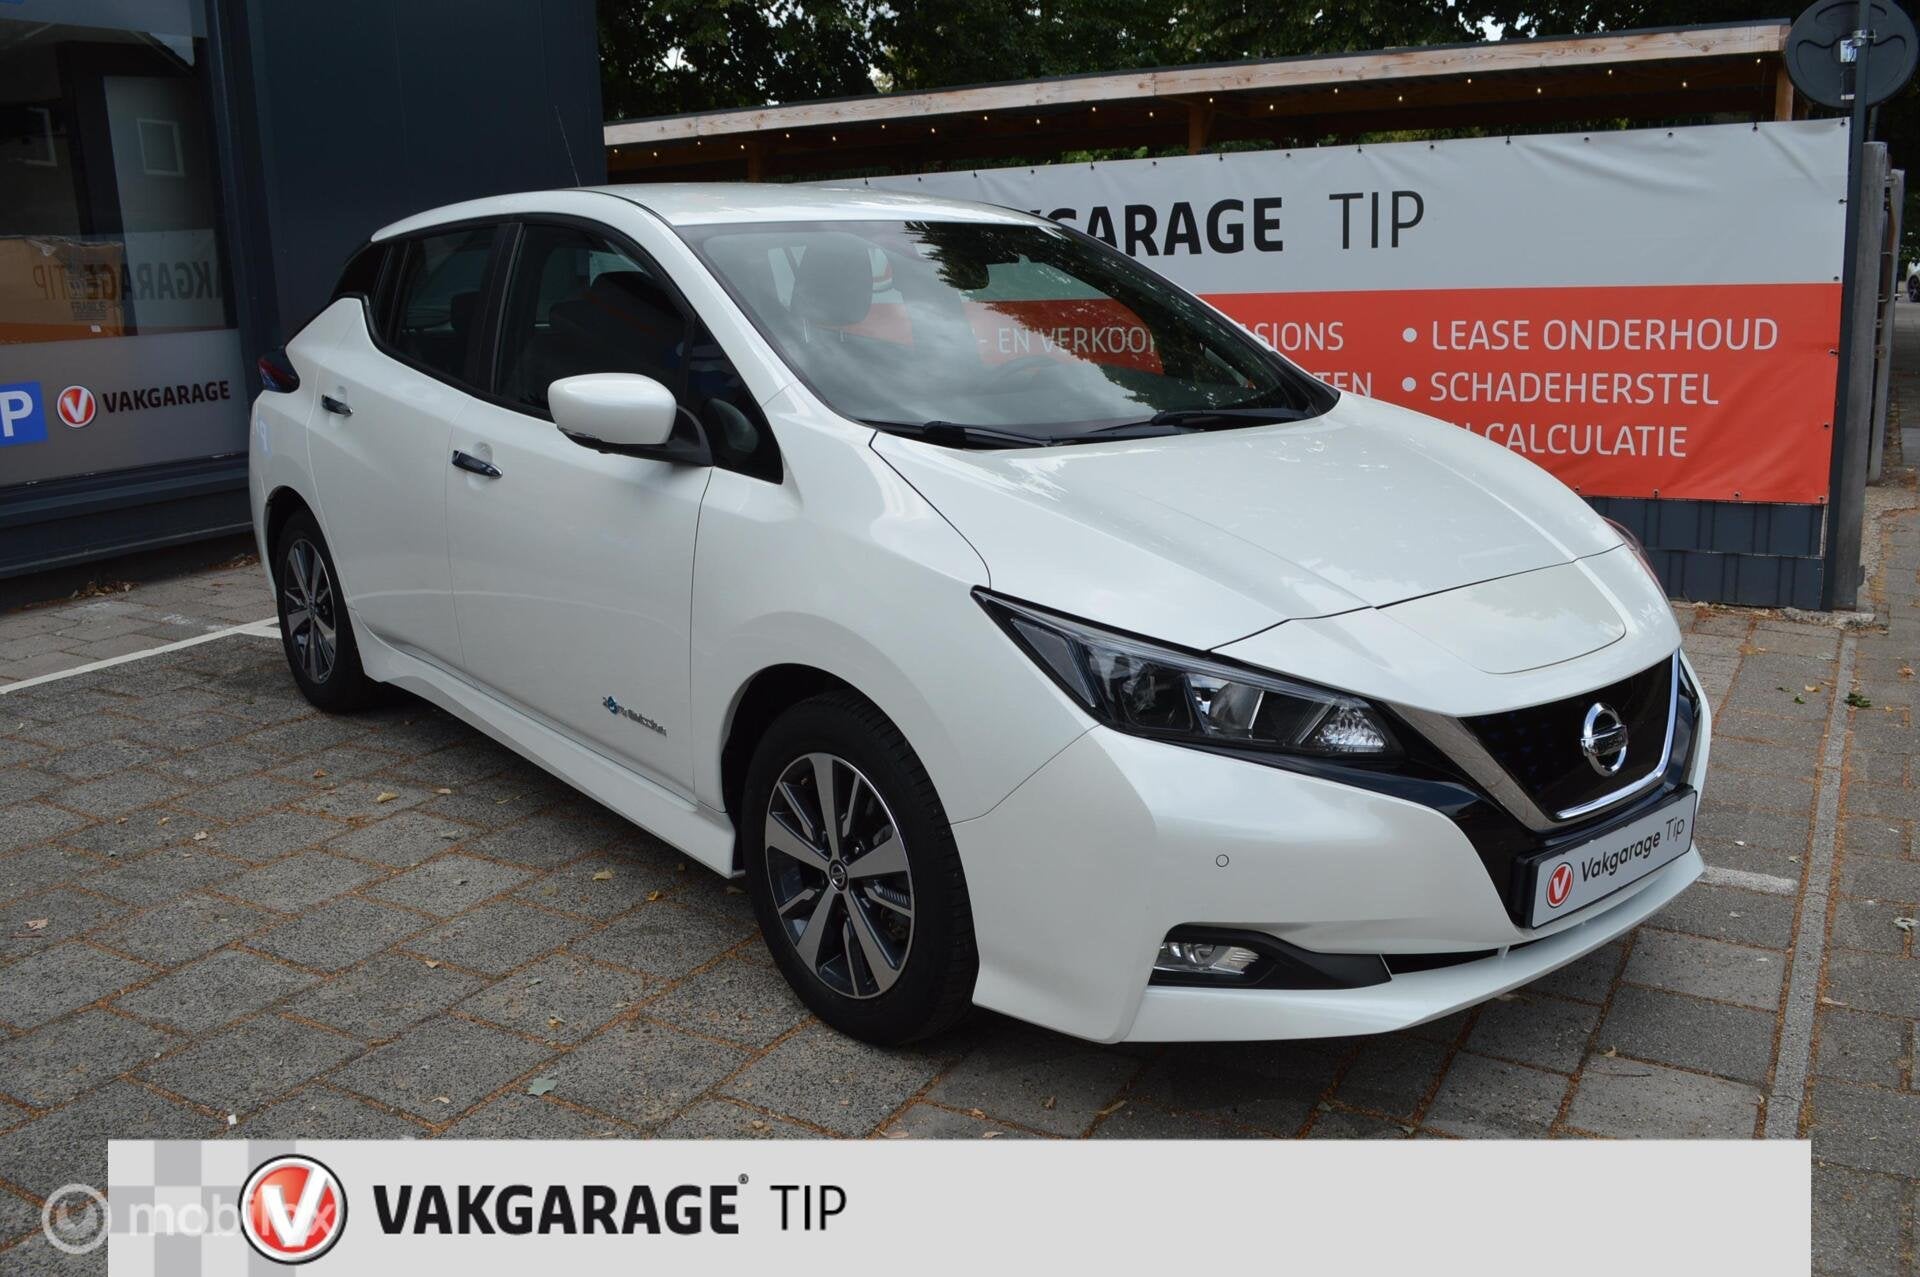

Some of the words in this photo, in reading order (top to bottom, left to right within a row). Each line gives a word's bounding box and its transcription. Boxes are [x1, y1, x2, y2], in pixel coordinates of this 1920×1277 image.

[1030, 197, 1283, 257] ARAGE
[1329, 190, 1424, 250] TIP
[998, 328, 1030, 354] EN
[1241, 322, 1344, 352] SIONS
[1432, 320, 1530, 350] LEASE
[1543, 318, 1778, 351] ONDERHOUD
[103, 380, 231, 414] VAKGARAGE
[1430, 371, 1719, 405] SCHADEHERSTEL
[0, 391, 33, 437] P
[1485, 422, 1687, 458] CALCULATIE
[1581, 832, 1660, 882] Vakgarage
[1666, 818, 1685, 841] Tip
